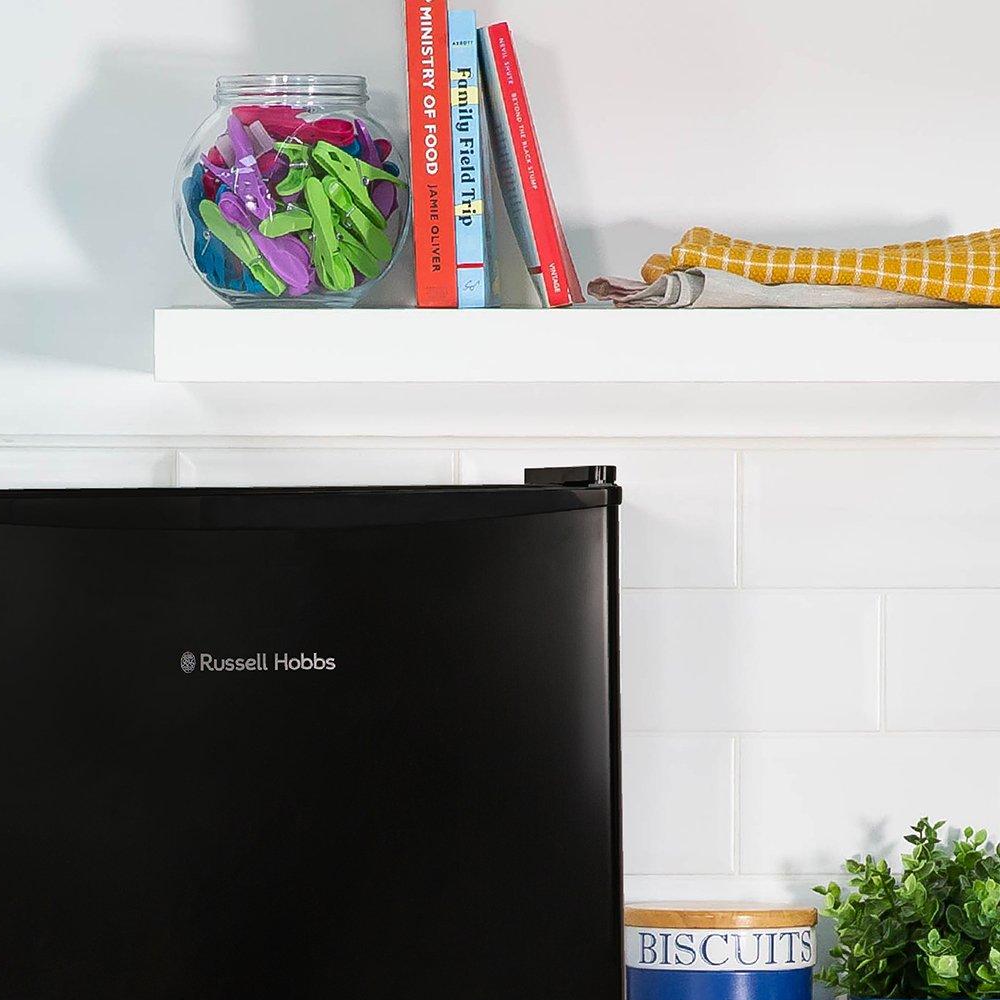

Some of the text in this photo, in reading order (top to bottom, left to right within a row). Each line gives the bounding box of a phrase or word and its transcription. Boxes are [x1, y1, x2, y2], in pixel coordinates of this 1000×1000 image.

[420, 6, 435, 90] MINISTRY
[423, 95, 436, 119] OF
[511, 92, 522, 123] BEYOND
[424, 125, 438, 175] FOOD
[456, 67, 476, 227] Family Field Trip
[427, 184, 440, 272] JAMIE OLIVER
[549, 262, 561, 293] VINTAGE
[200, 652, 336, 672] Russell Hobbs
[638, 930, 812, 966] BISCUITS
